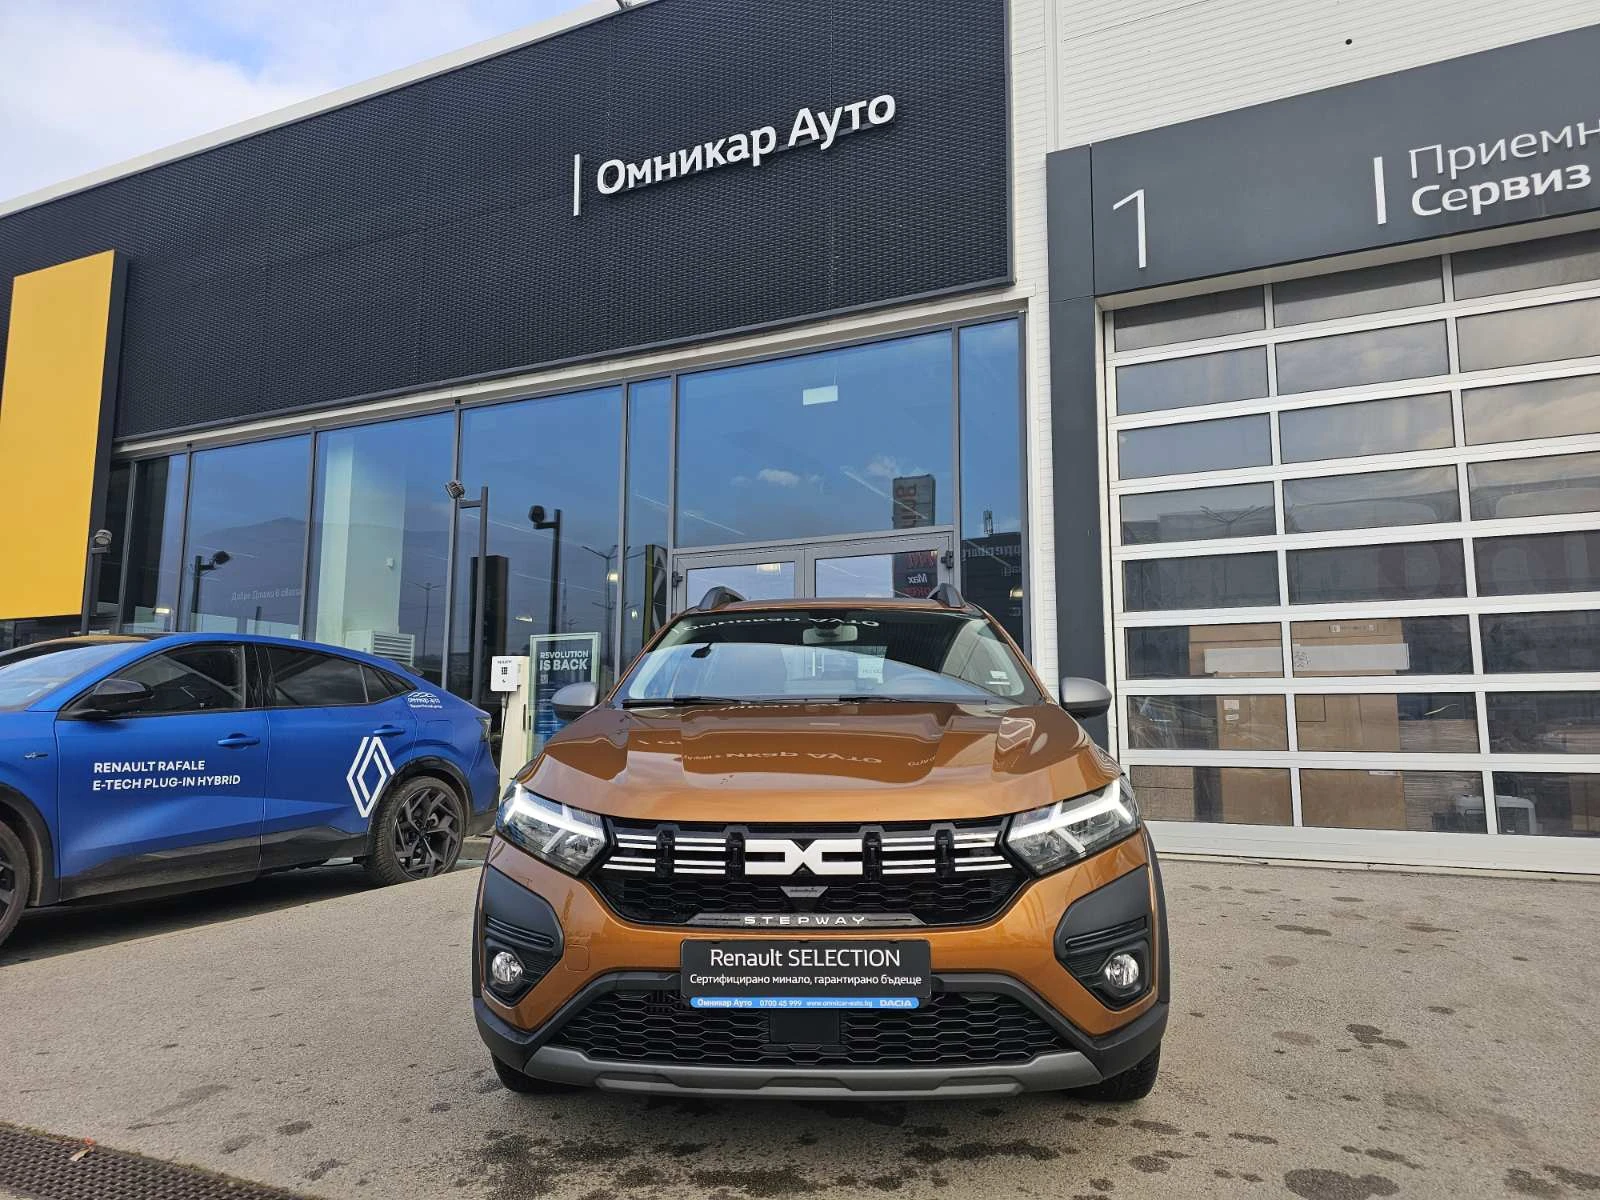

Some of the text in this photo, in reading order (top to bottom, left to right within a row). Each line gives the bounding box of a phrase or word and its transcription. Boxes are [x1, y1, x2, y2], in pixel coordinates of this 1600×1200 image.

[597, 94, 896, 195] Омникар Ауто
[1408, 117, 1600, 180] Приемн
[1411, 164, 1592, 216] Сервиз
[1112, 188, 1147, 269] 1
[540, 658, 588, 671] IS BACK
[94, 760, 205, 773] RENAULT RAFALE
[92, 774, 241, 791] E-TECH PLUG-IN HYBRID
[744, 916, 866, 926] STEPWAY
[710, 948, 901, 967] Renault SELECTION
[689, 973, 922, 987] Сертифицирано минало, гарантирано бъдеще
[697, 998, 732, 1008] Омникар
[733, 998, 753, 1008] Ауто
[879, 999, 912, 1007] DACIA
